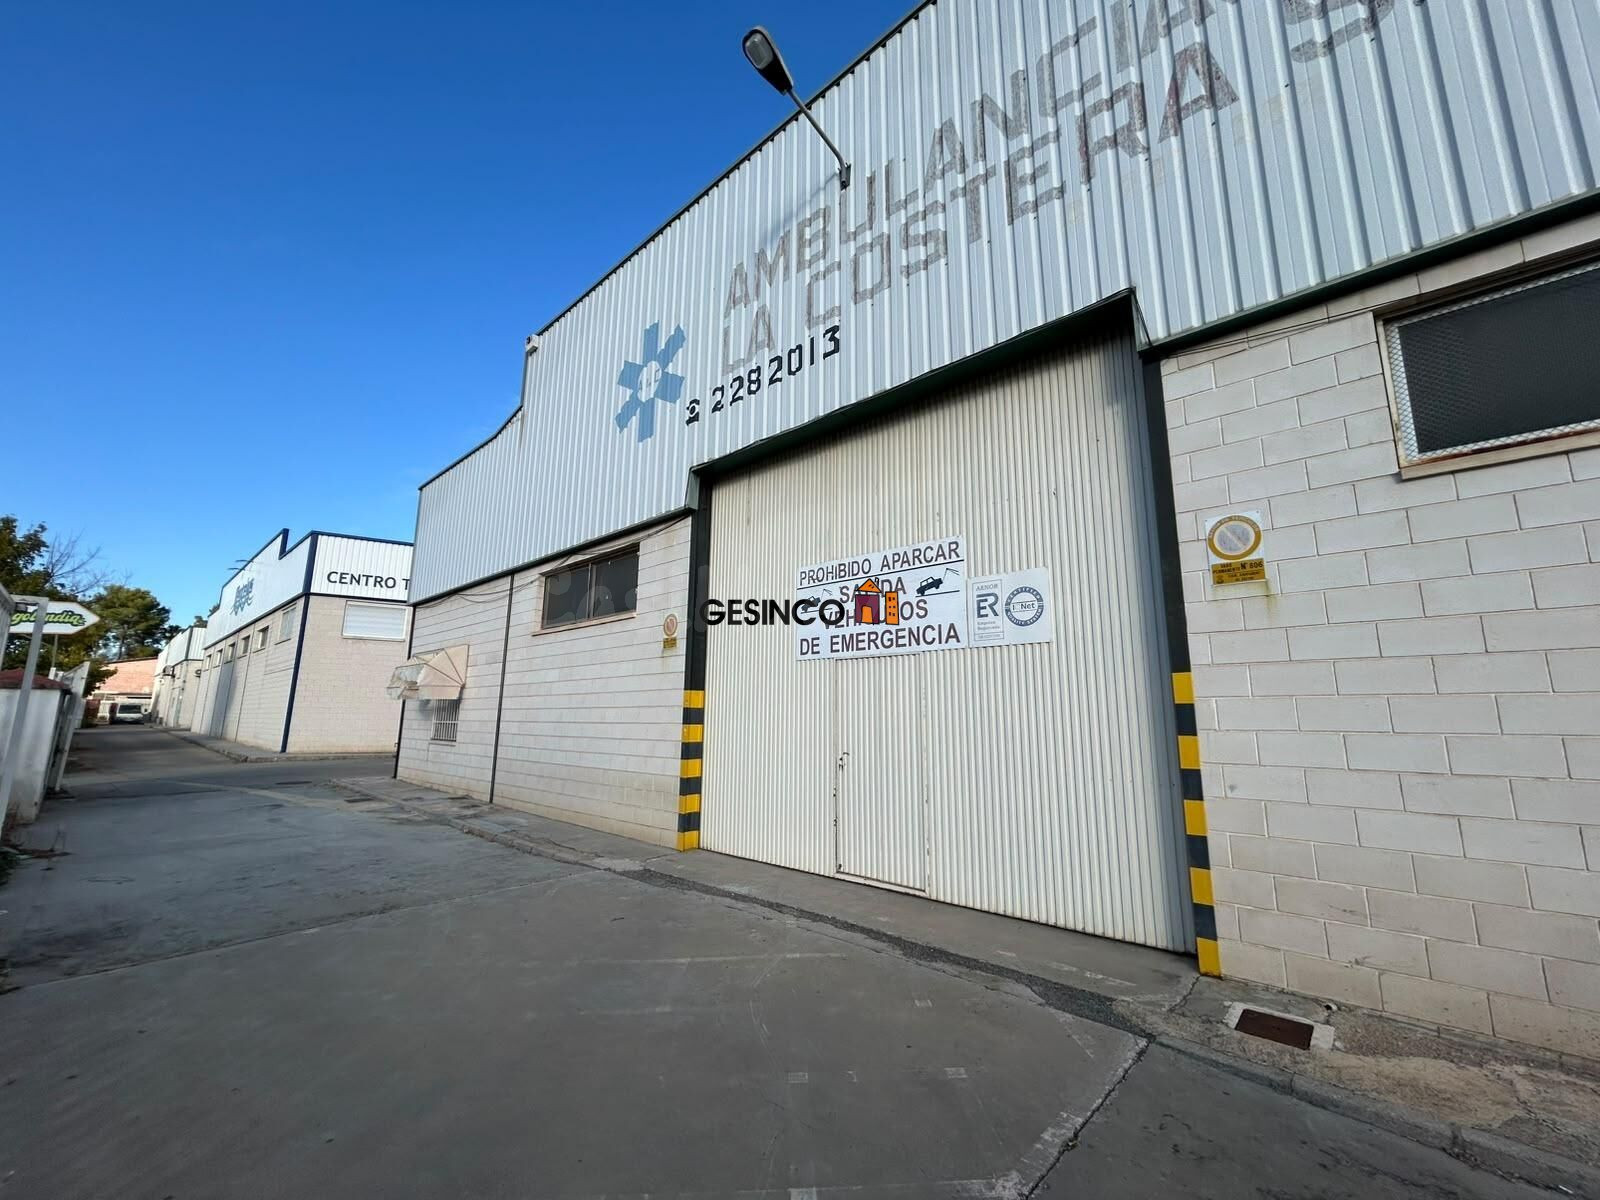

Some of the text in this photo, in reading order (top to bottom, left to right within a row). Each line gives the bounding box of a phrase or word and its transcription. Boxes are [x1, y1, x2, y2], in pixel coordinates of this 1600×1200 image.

[721, 42, 1241, 377] LA COSTERA
[711, 324, 841, 414] 2282013
[326, 571, 397, 589] CENTRO
[799, 541, 960, 586] PROHIBIDO APARCAR
[839, 577, 907, 604] SADA
[799, 623, 962, 656] DE EMERGENCIA
